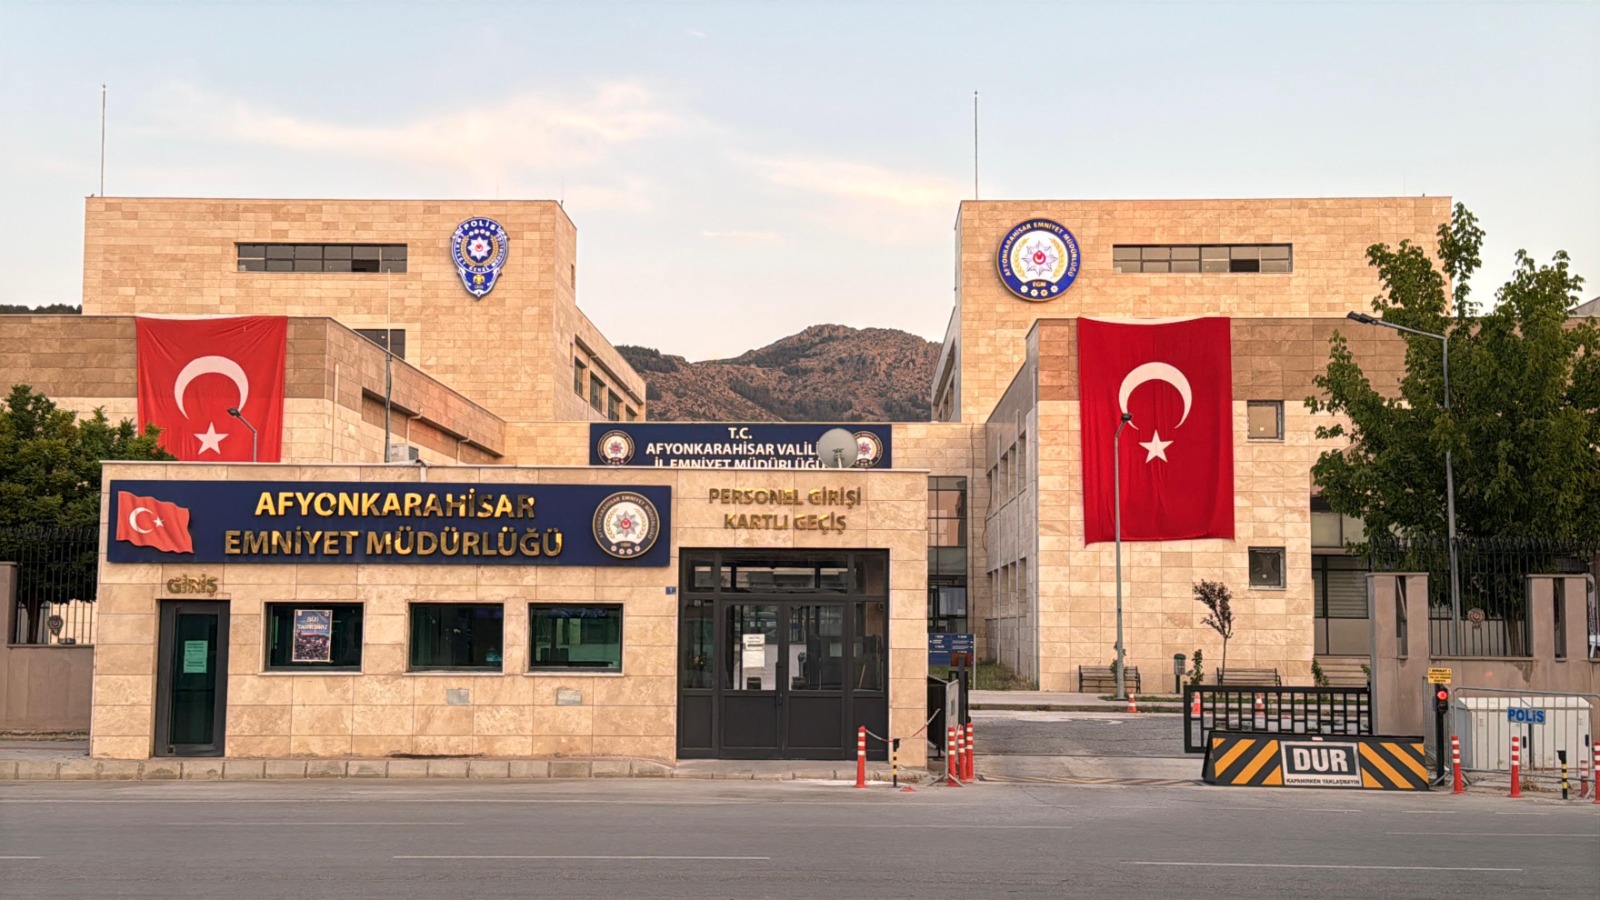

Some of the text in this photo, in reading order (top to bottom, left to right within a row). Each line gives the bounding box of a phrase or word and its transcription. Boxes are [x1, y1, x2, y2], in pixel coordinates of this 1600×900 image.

[464, 218, 496, 230] POLİS
[1033, 222, 1064, 234] EMNİYET
[728, 427, 752, 440] T.C.
[646, 441, 774, 456] AFYONKARAHİSAR
[254, 488, 536, 518] AFYONKARAHİSAR
[708, 486, 862, 508] PERSONEL GİRİŞİ
[724, 512, 846, 534] KARTLI GEÇİŞ
[224, 526, 563, 557] EMNİYET MÜDÜRLÜĞÜ
[167, 574, 218, 596] GİRİŞ
[1292, 748, 1348, 772] DUR
